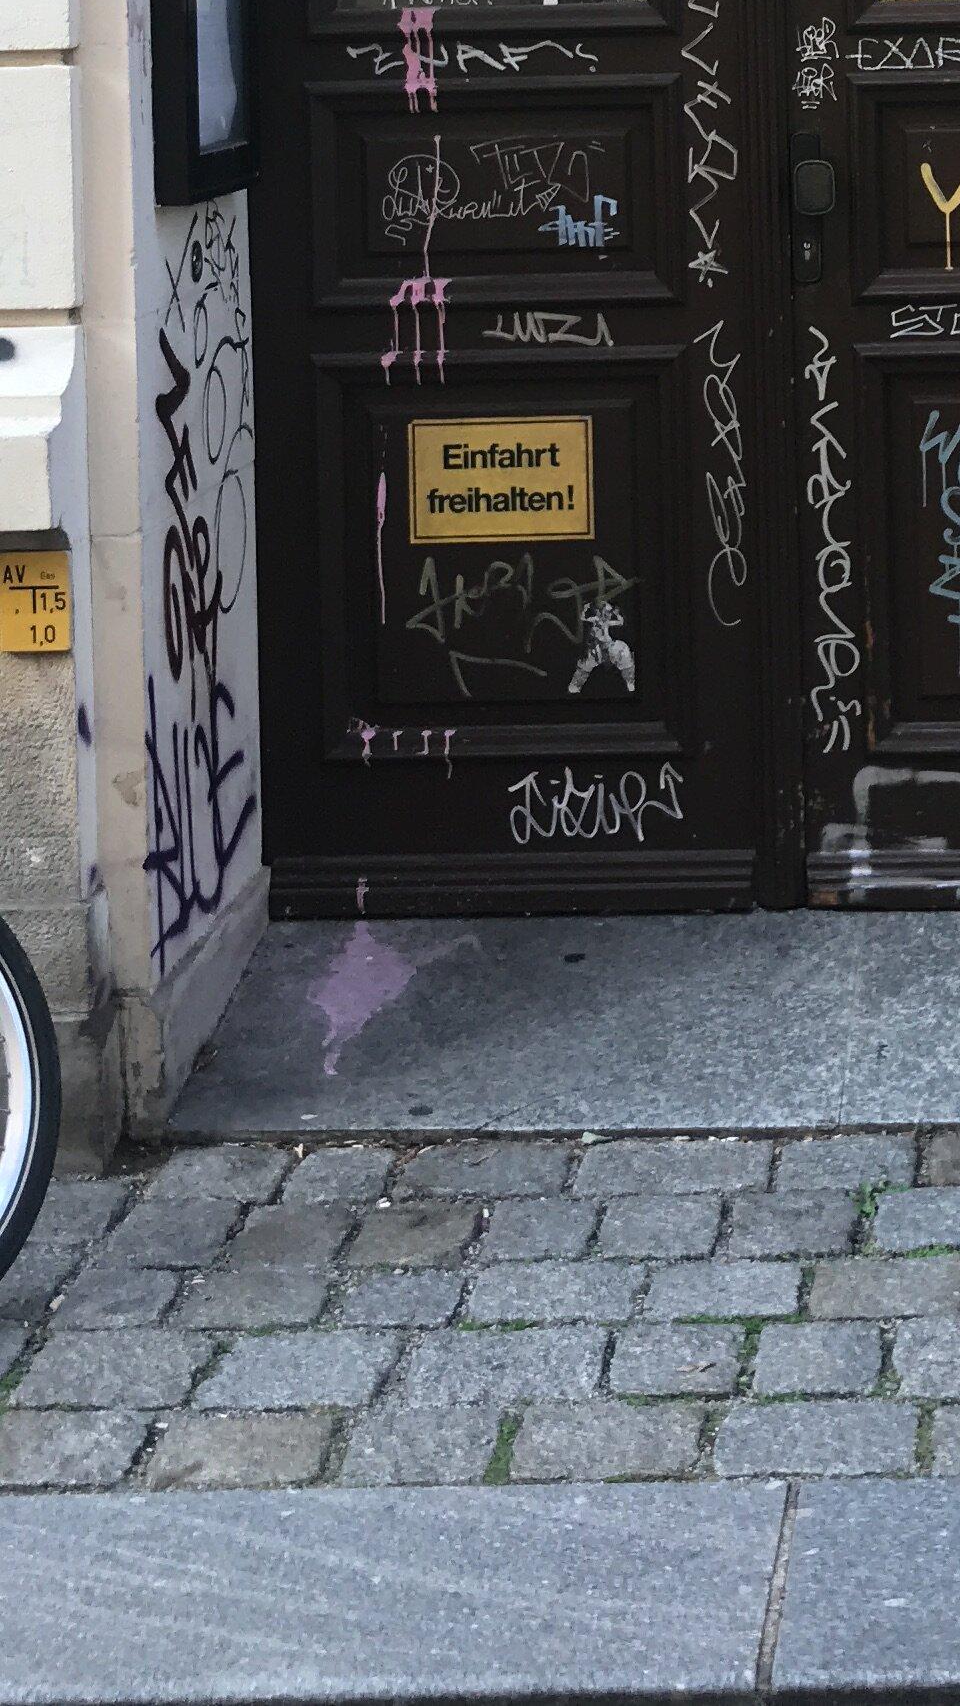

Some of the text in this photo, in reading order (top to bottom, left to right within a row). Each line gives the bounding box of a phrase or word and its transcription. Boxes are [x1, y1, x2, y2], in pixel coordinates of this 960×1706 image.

[443, 442, 560, 470] Einfahrt
[427, 484, 575, 515] freihalten!
[40, 591, 67, 614] 1,5
[30, 624, 56, 647] 1,0
